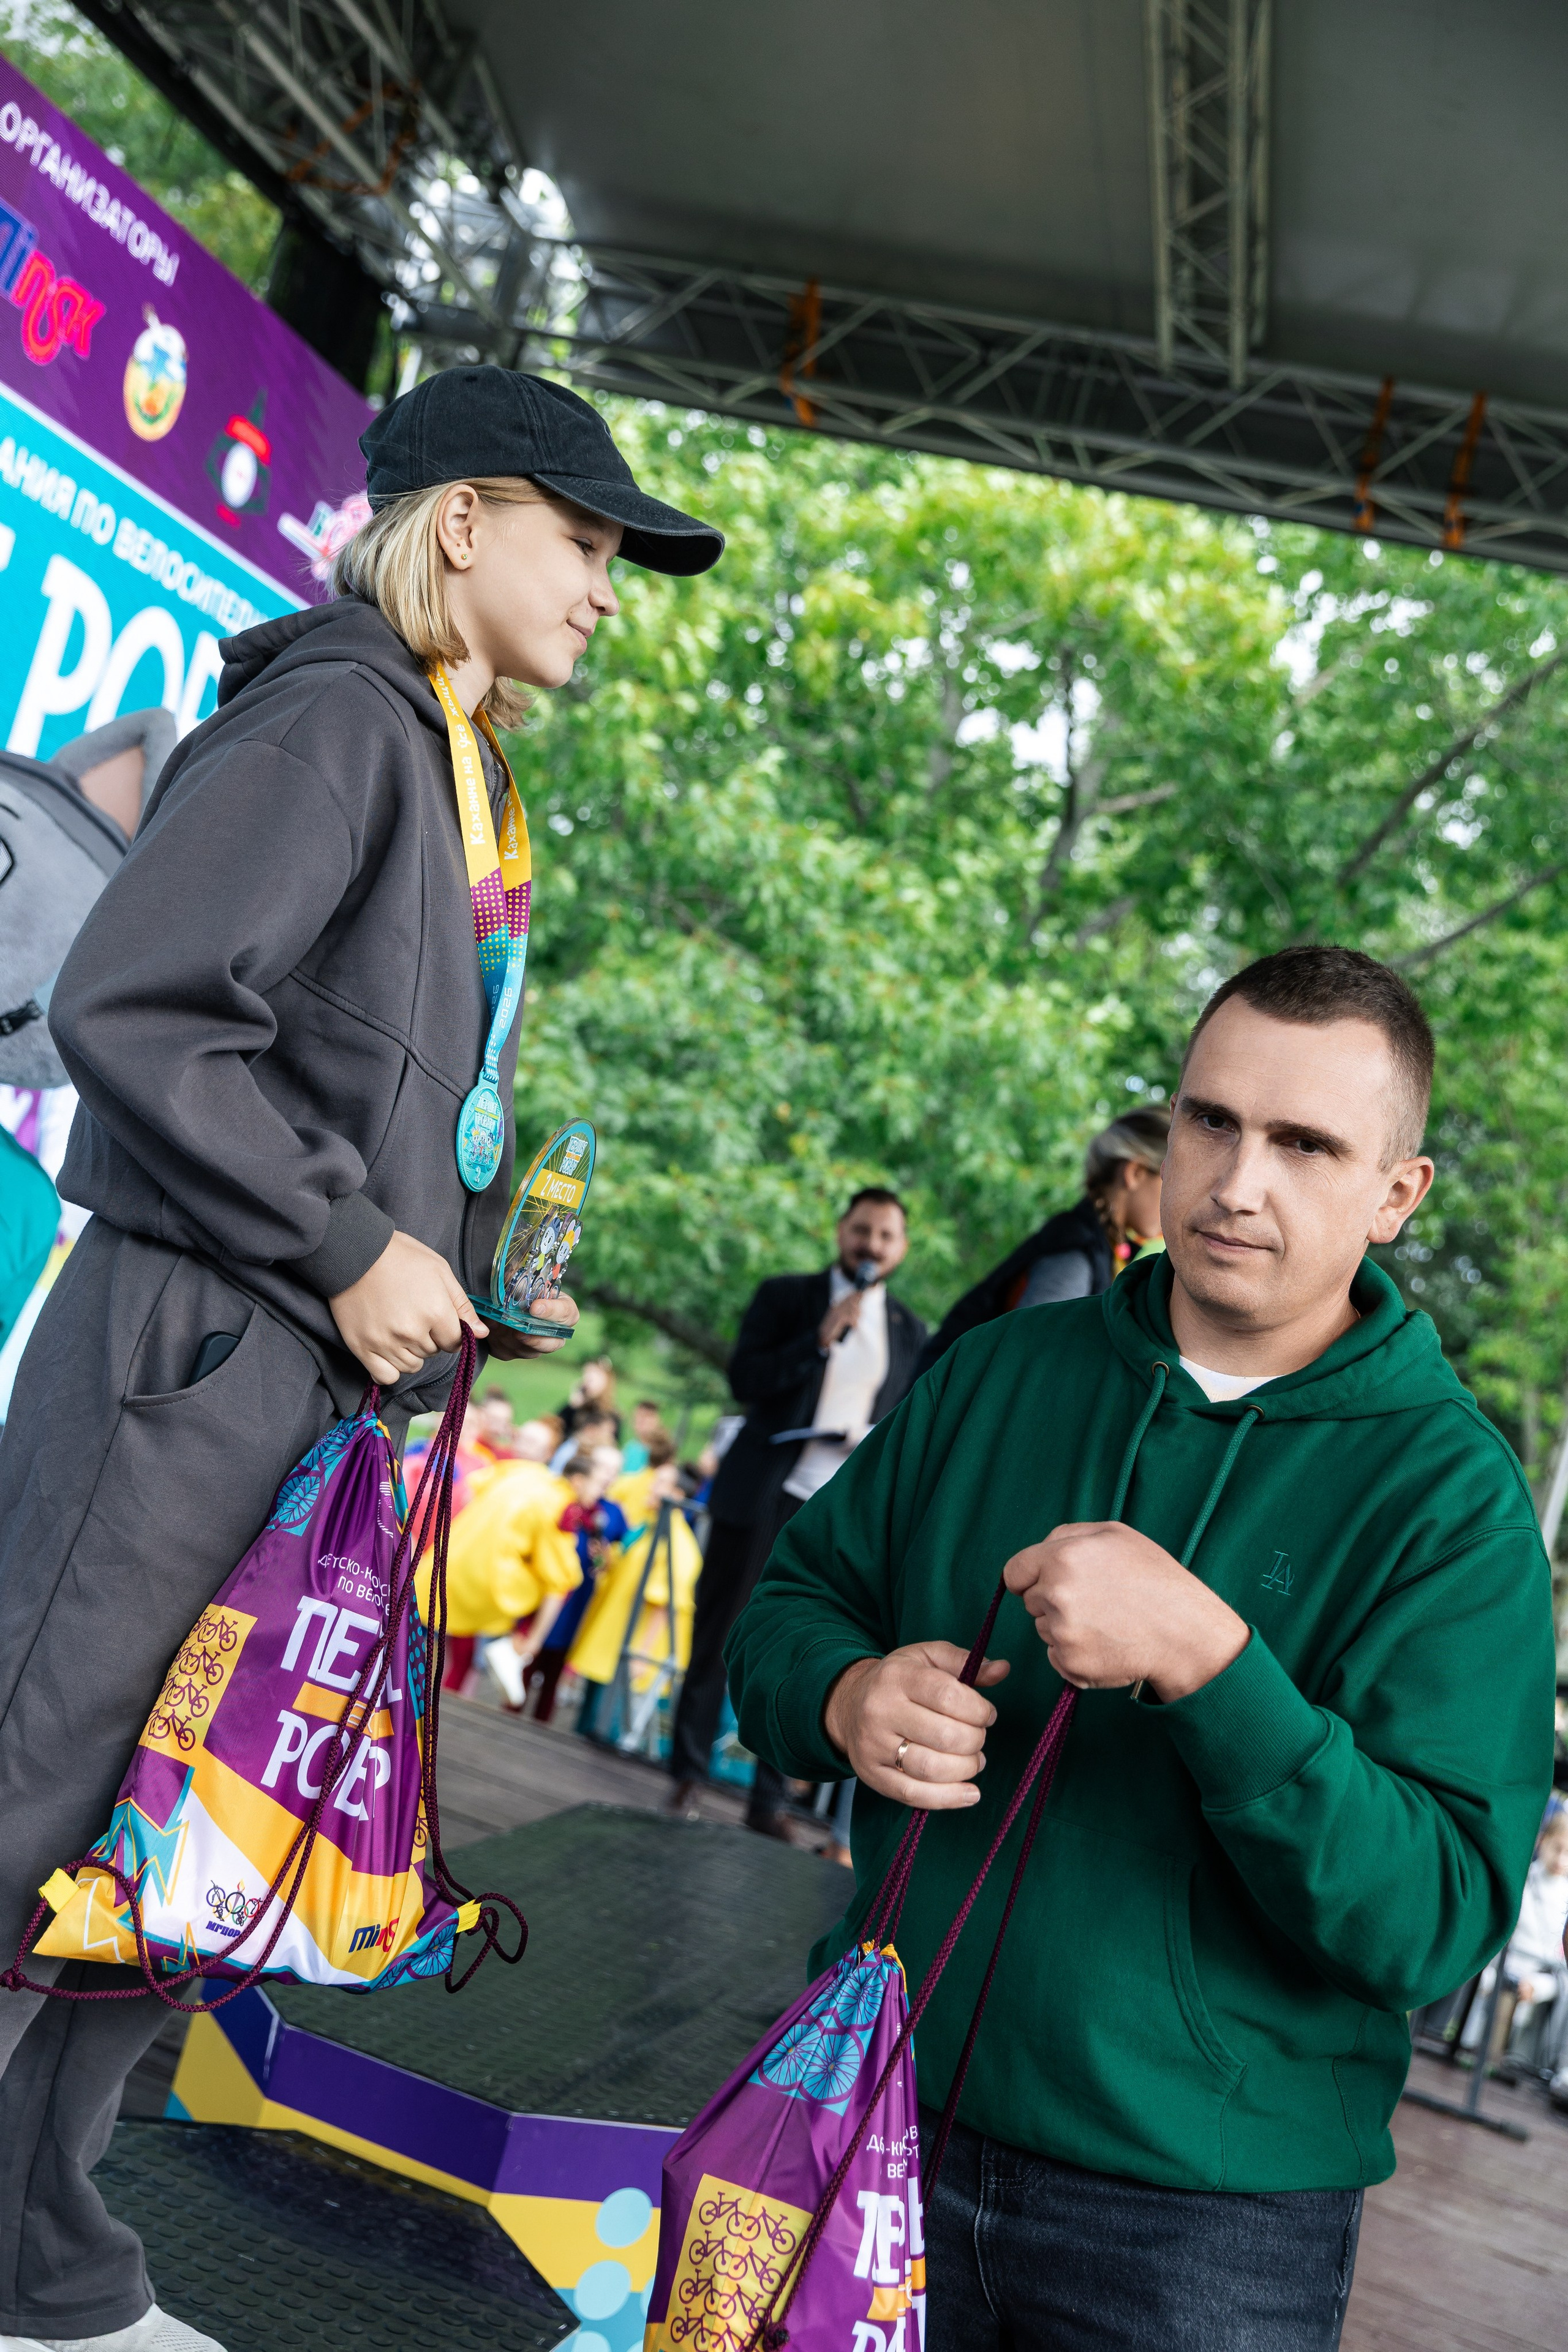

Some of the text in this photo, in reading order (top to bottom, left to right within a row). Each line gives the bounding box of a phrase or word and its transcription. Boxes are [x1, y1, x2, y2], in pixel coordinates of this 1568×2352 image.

[69, 488, 116, 546] ПО
[458, 723, 472, 748] ўсё
[462, 756, 473, 774] на
[466, 778, 486, 845] Каханне
[503, 807, 519, 860] Каханне
[499, 987, 513, 1029] 2026
[540, 1173, 576, 1204] 2 МЕСТО
[337, 1575, 353, 1594] ПО
[206, 1920, 241, 1938] МГЦОР
